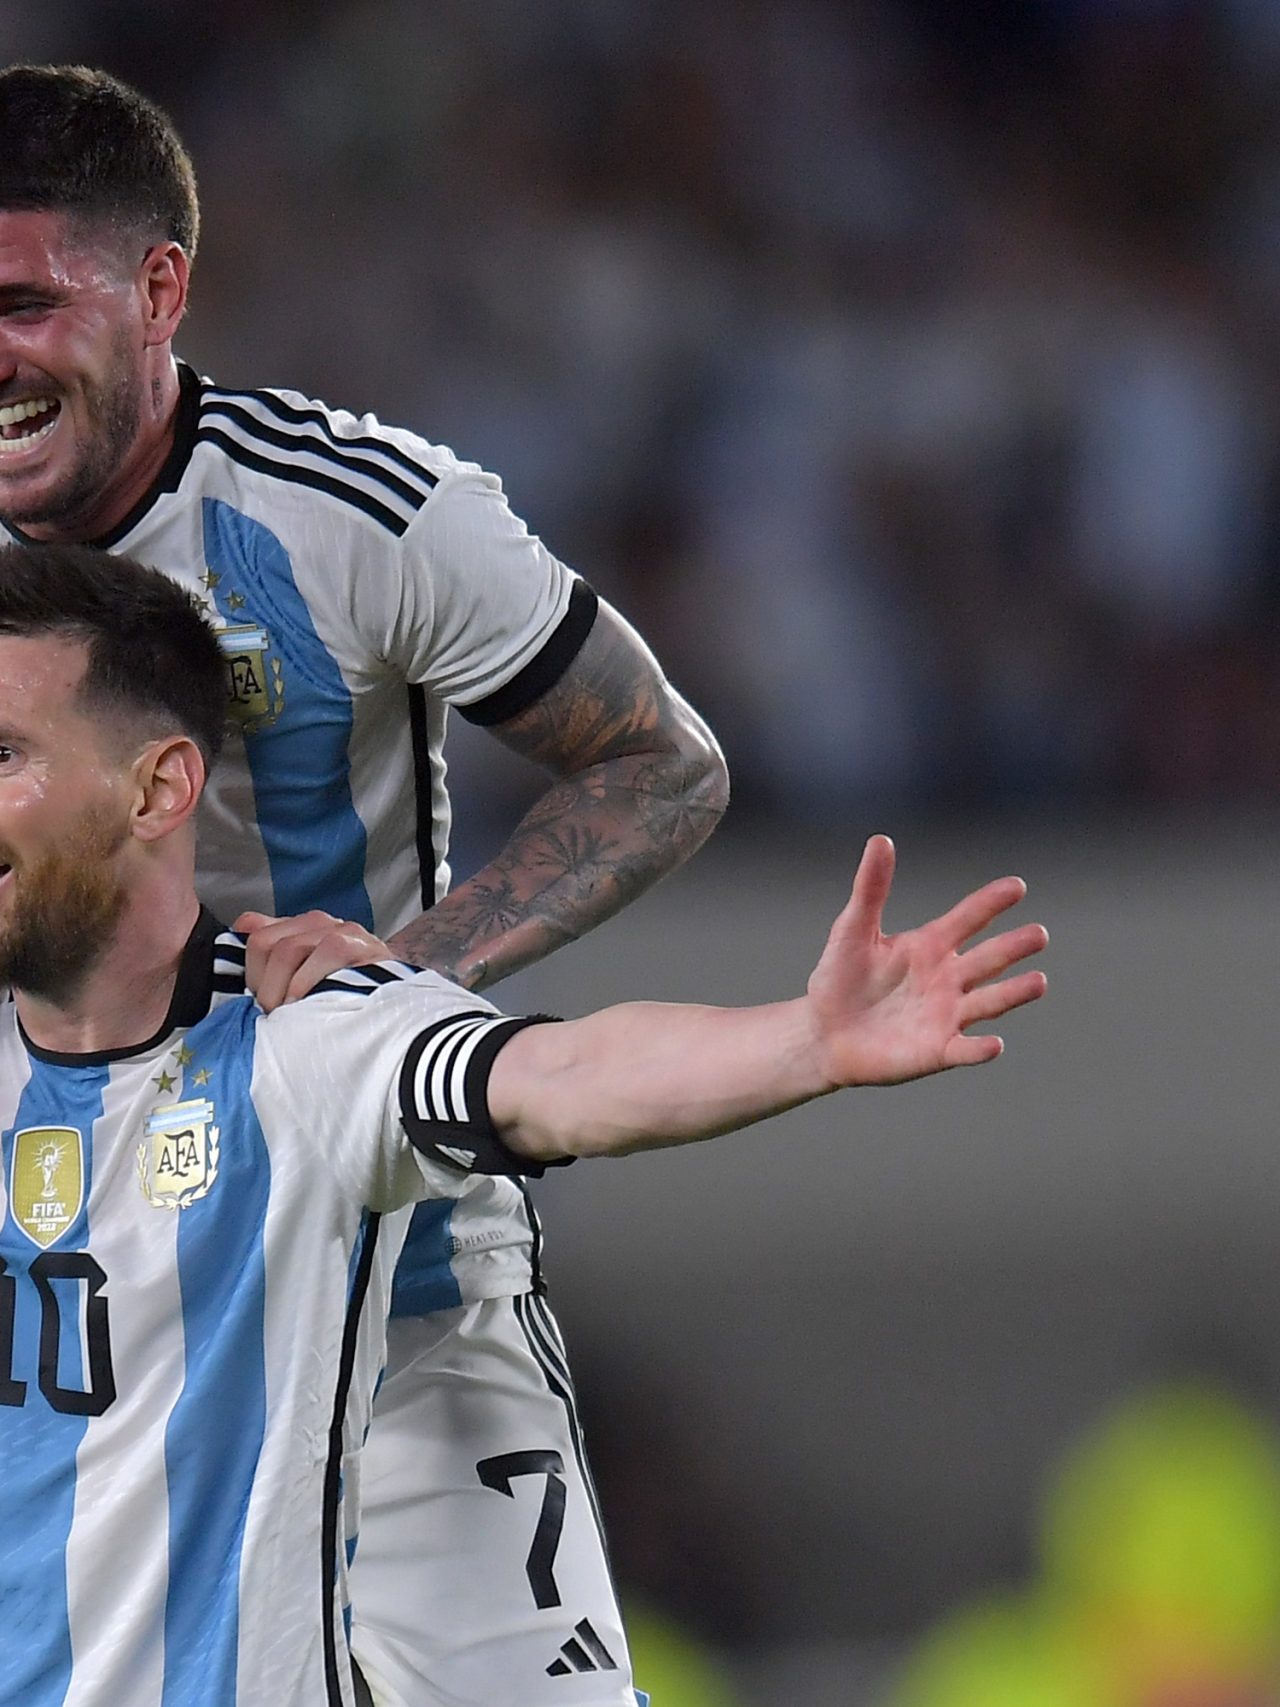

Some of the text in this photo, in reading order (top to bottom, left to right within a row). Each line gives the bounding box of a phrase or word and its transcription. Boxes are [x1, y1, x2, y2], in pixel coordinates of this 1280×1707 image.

[223, 655, 262, 704] FA
[156, 1129, 200, 1177] AFA
[32, 1202, 64, 1218] FIFA
[475, 1449, 568, 1611] 7
